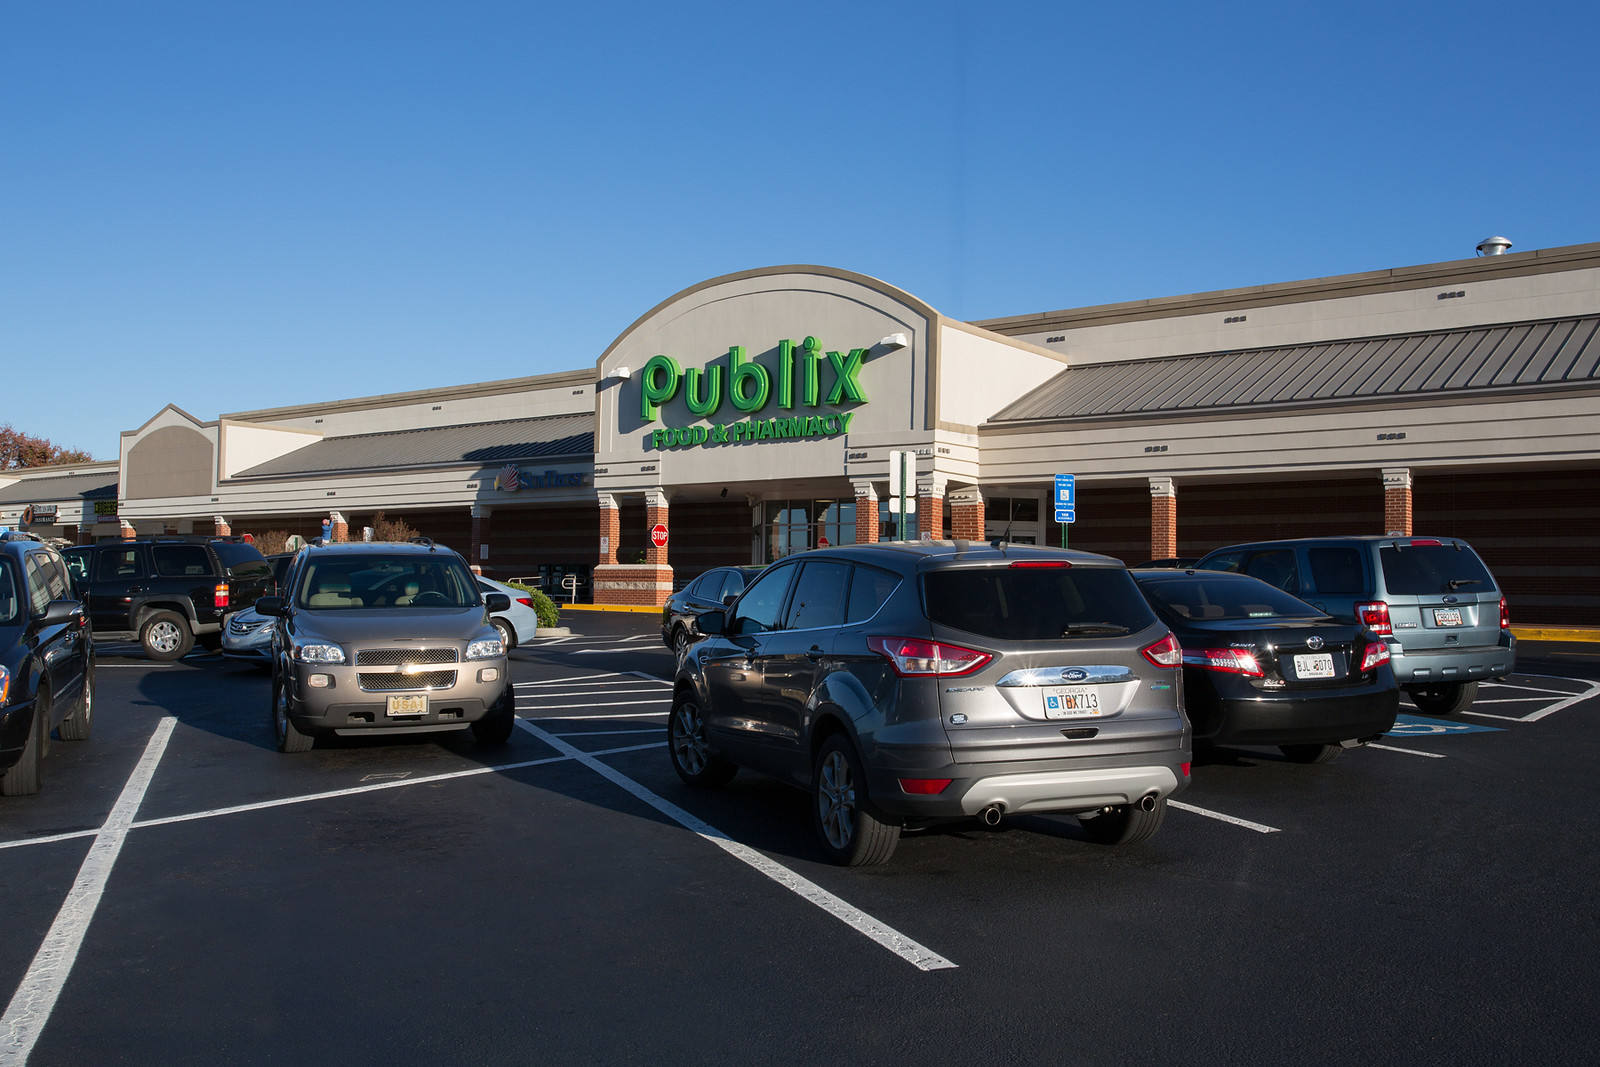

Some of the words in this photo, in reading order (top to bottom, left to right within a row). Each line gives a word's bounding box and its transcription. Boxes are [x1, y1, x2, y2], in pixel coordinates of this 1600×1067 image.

[640, 336, 869, 421] Publix
[652, 425, 708, 448] FOOD
[712, 424, 729, 443] &
[734, 413, 855, 441] PHARMACY
[653, 531, 667, 540] STOP
[1058, 693, 1098, 710] TBX713
